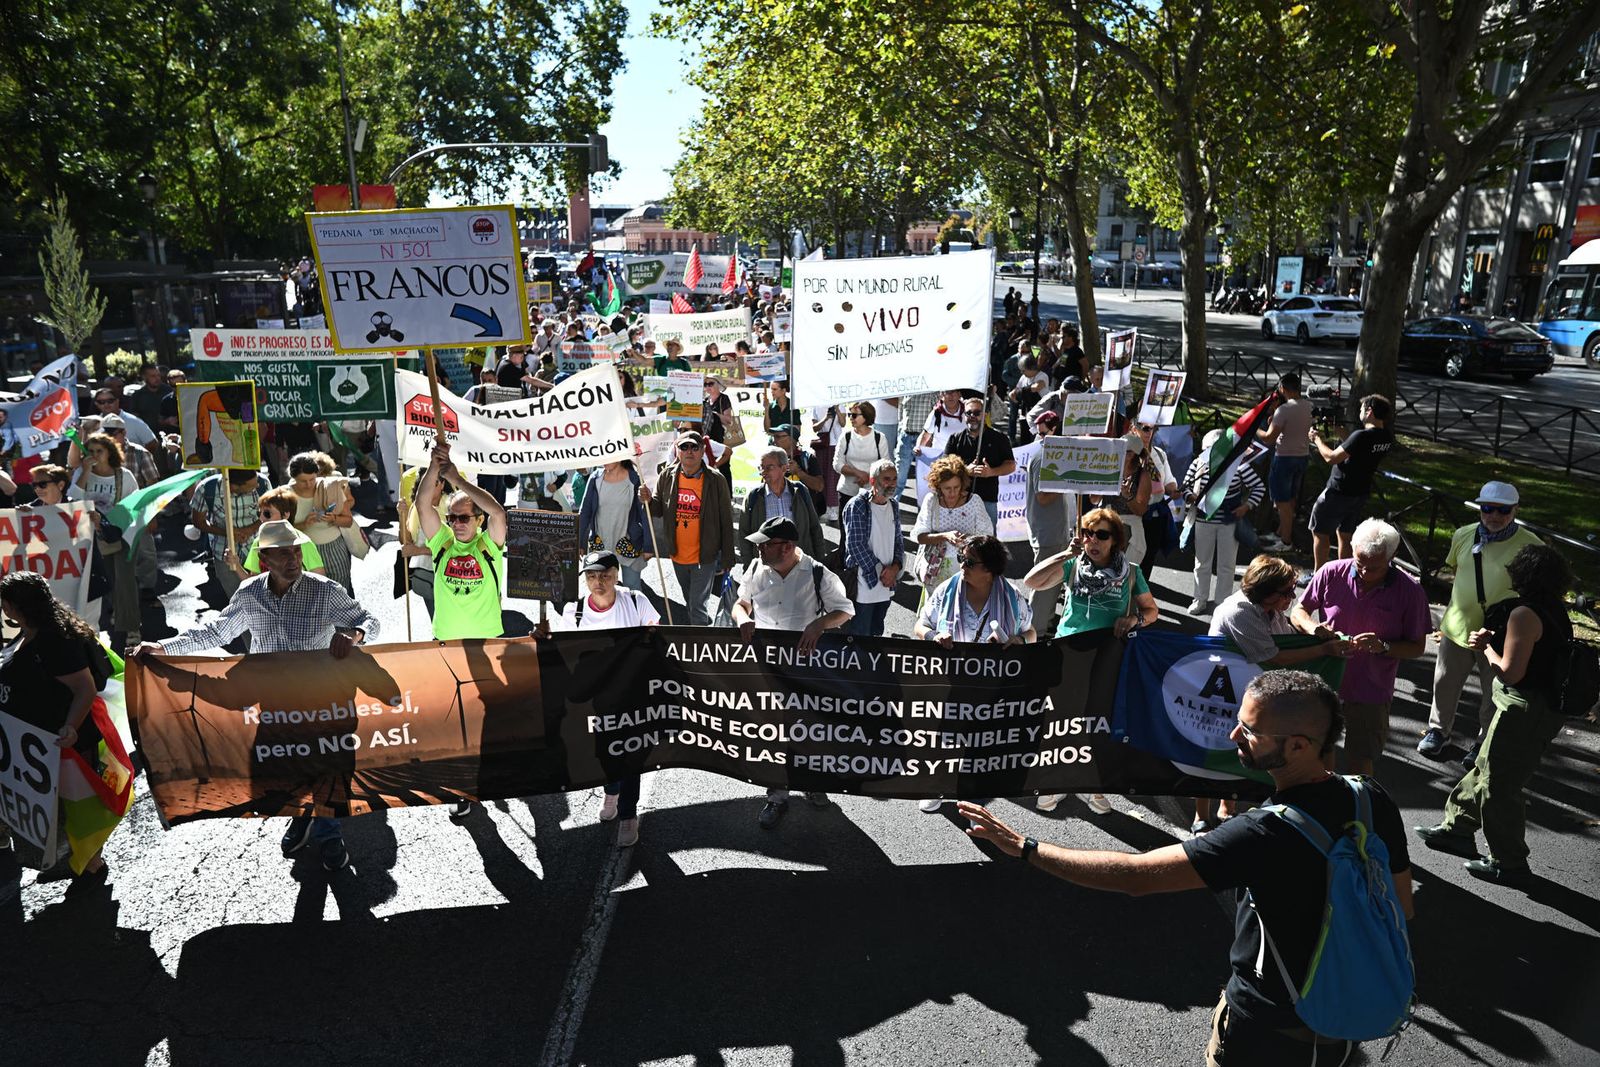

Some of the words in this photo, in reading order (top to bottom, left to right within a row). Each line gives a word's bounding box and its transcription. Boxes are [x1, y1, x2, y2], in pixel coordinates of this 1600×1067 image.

[390, 225, 439, 236] MACHACÓN
[380, 244, 393, 260] N
[402, 242, 432, 258] 501
[327, 263, 510, 302] FRANCOS
[803, 277, 828, 294] POR
[836, 277, 854, 294] UN
[858, 277, 898, 295] MUNDO
[903, 275, 943, 291] RURAL
[863, 306, 919, 333] VIVO
[246, 336, 256, 349] ES
[311, 336, 321, 349] ES
[827, 344, 849, 361] SIN
[860, 338, 914, 359] LIMOSNAS
[243, 363, 263, 373] NOS
[268, 363, 300, 373] GUSTA
[282, 374, 312, 387] FINCA
[268, 391, 302, 402] TOCAR
[33, 400, 69, 421] STOP
[264, 403, 313, 418] GRACIAS
[498, 427, 531, 442] SIN
[537, 420, 593, 440] OLOR
[467, 451, 485, 463] NI
[489, 438, 629, 464] CONTAMINACIÓN
[1046, 450, 1064, 460] NO
[1067, 451, 1073, 461] A
[1076, 452, 1089, 462] LA
[1091, 452, 1120, 463] MINA
[1371, 442, 1392, 453] STAFF
[57, 510, 82, 539] Y
[451, 558, 477, 569] STOP
[665, 643, 758, 663] ALIANZA
[765, 645, 861, 671] ENERGÍA
[868, 652, 882, 671] Y
[887, 654, 1022, 677] TERRITORIO
[648, 679, 696, 701] POR
[701, 689, 754, 711] UNA
[756, 691, 904, 718] TRANSICIÓN
[911, 695, 1055, 720] ENERGÉTICA
[243, 700, 384, 725] Renovables
[587, 704, 723, 734] REALMENTE
[728, 719, 873, 747] ECOLÓGICA,
[879, 728, 1021, 750] SOSTENIBLE
[1026, 725, 1041, 742] Y
[1043, 716, 1112, 740] JUSTA
[255, 742, 311, 763] pero
[318, 733, 362, 755] NO
[369, 723, 418, 749] ASÍ.
[608, 730, 660, 756] CON
[664, 729, 740, 758] TODAS
[745, 746, 787, 765] LAS
[793, 754, 920, 776] PERSONAS
[923, 760, 942, 776] Y
[944, 746, 1092, 774] TERRITORIOS
